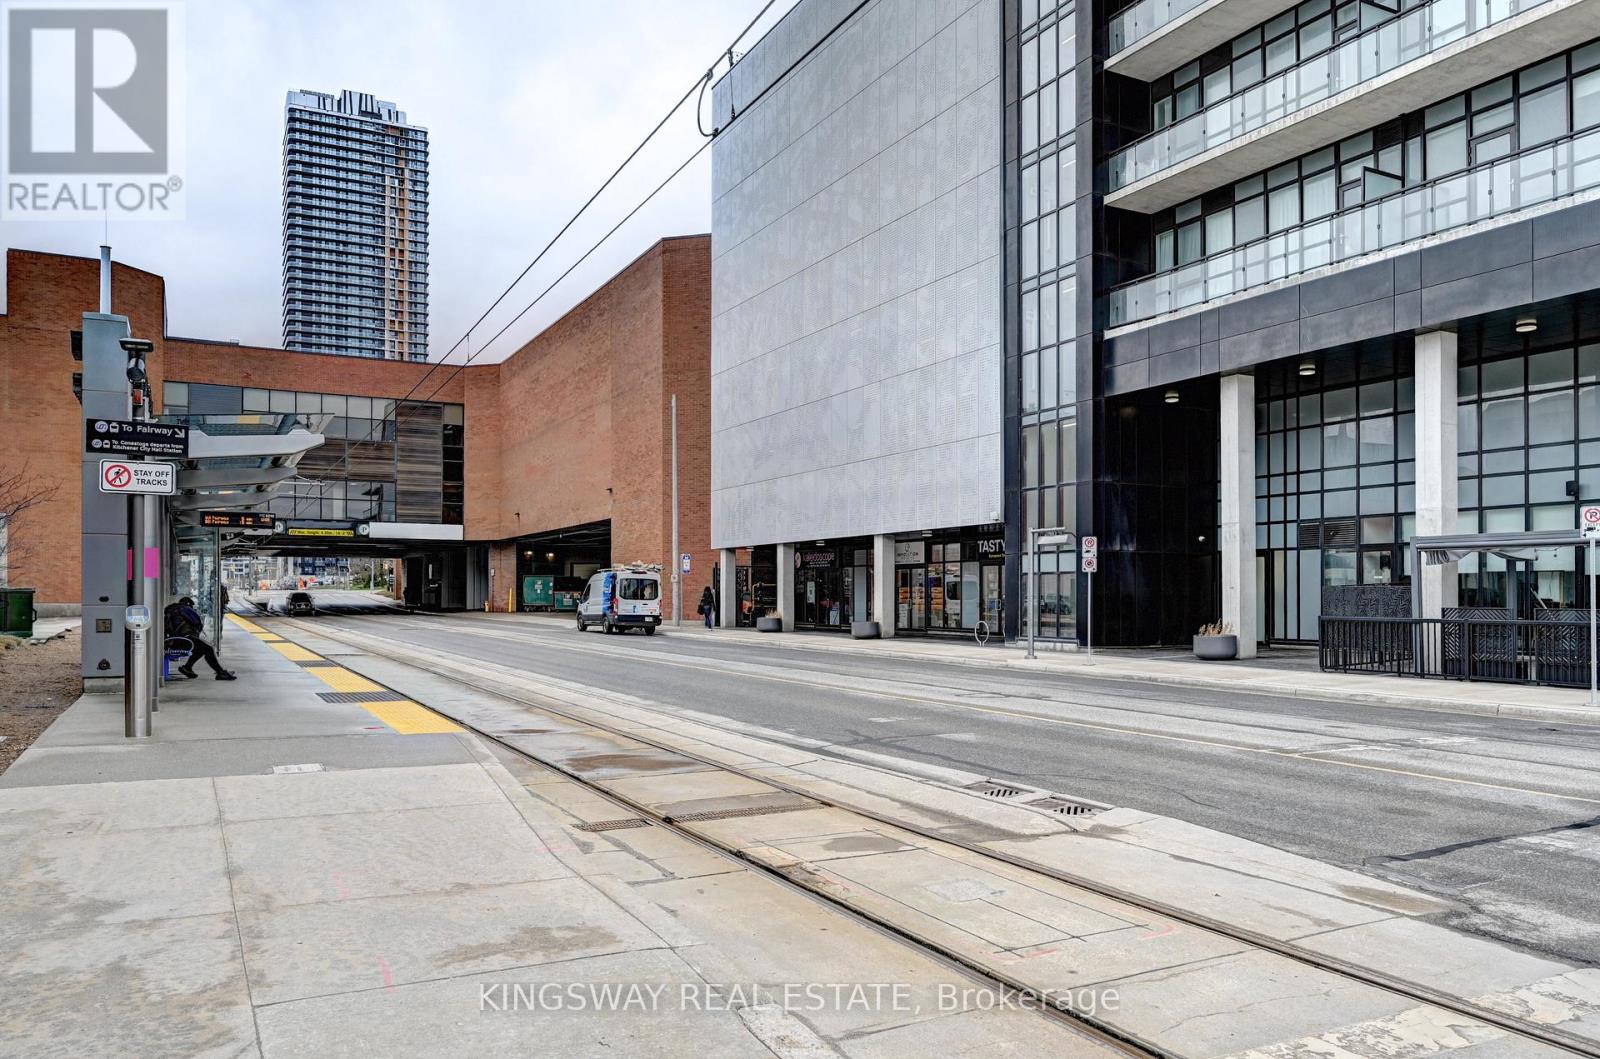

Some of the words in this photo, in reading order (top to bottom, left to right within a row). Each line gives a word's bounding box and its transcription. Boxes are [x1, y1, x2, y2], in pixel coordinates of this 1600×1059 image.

[122, 424, 132, 432] To
[137, 425, 173, 436] Fairway
[977, 539, 1005, 553] TASTY
